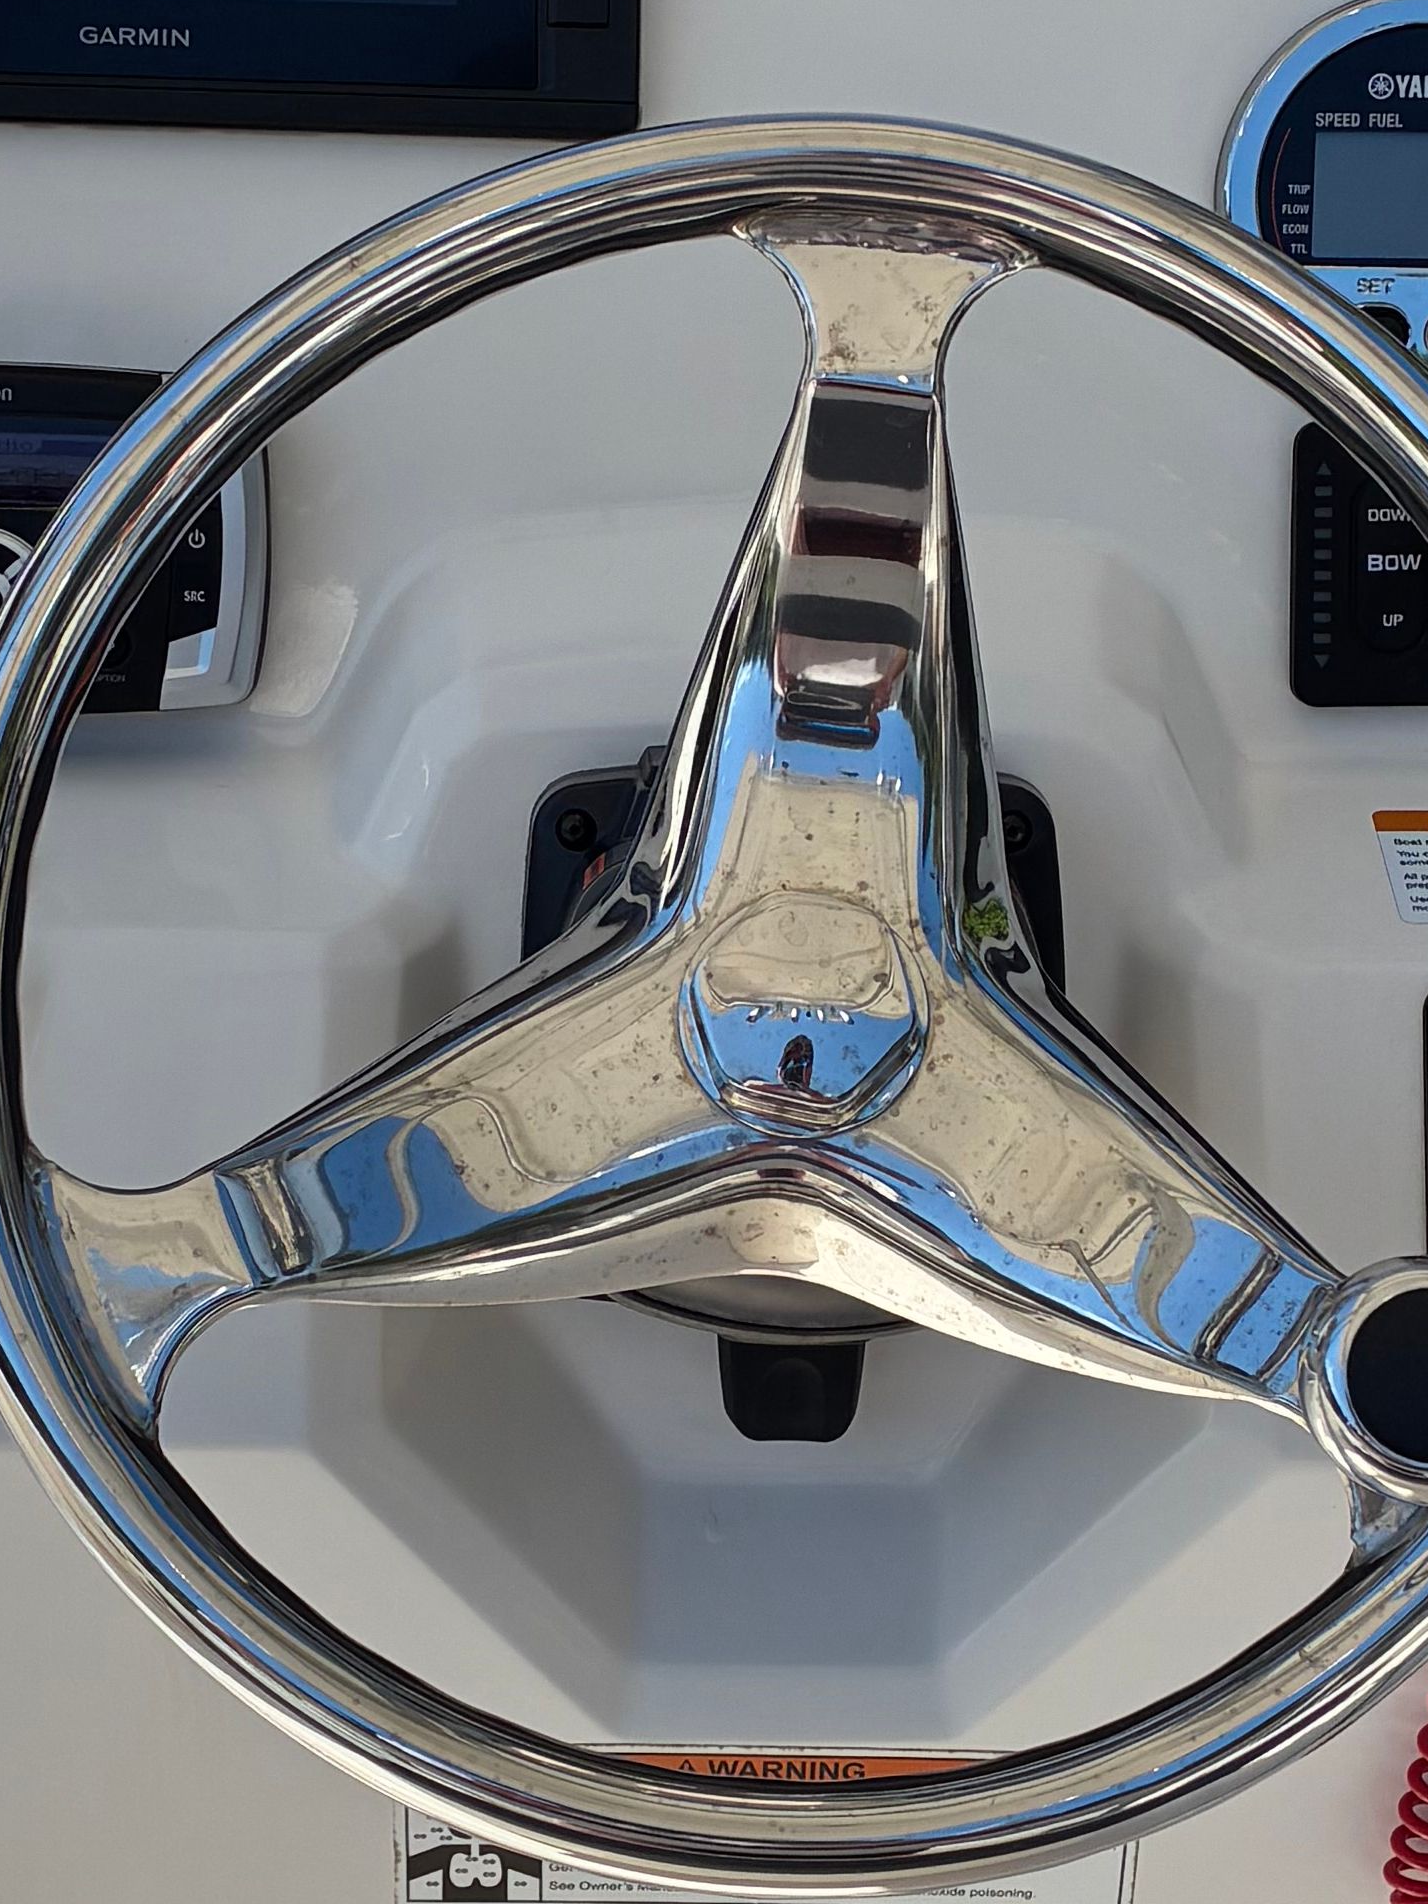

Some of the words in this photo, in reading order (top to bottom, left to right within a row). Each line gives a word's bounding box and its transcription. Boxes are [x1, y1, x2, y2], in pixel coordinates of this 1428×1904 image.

[78, 26, 190, 47] GARMIN
[1315, 113, 1361, 128] SPEED
[1368, 113, 1403, 128] FUEL
[1288, 184, 1311, 195] TRIP
[1281, 204, 1310, 215] FLOW
[1282, 224, 1309, 235] ECON
[1290, 243, 1308, 254] TTL
[1356, 278, 1395, 294] SET
[1367, 508, 1411, 522] DOW
[1366, 553, 1422, 572] BOW
[184, 590, 206, 602] SRC
[1382, 613, 1404, 627] UP
[708, 1759, 866, 1781] WARNING
